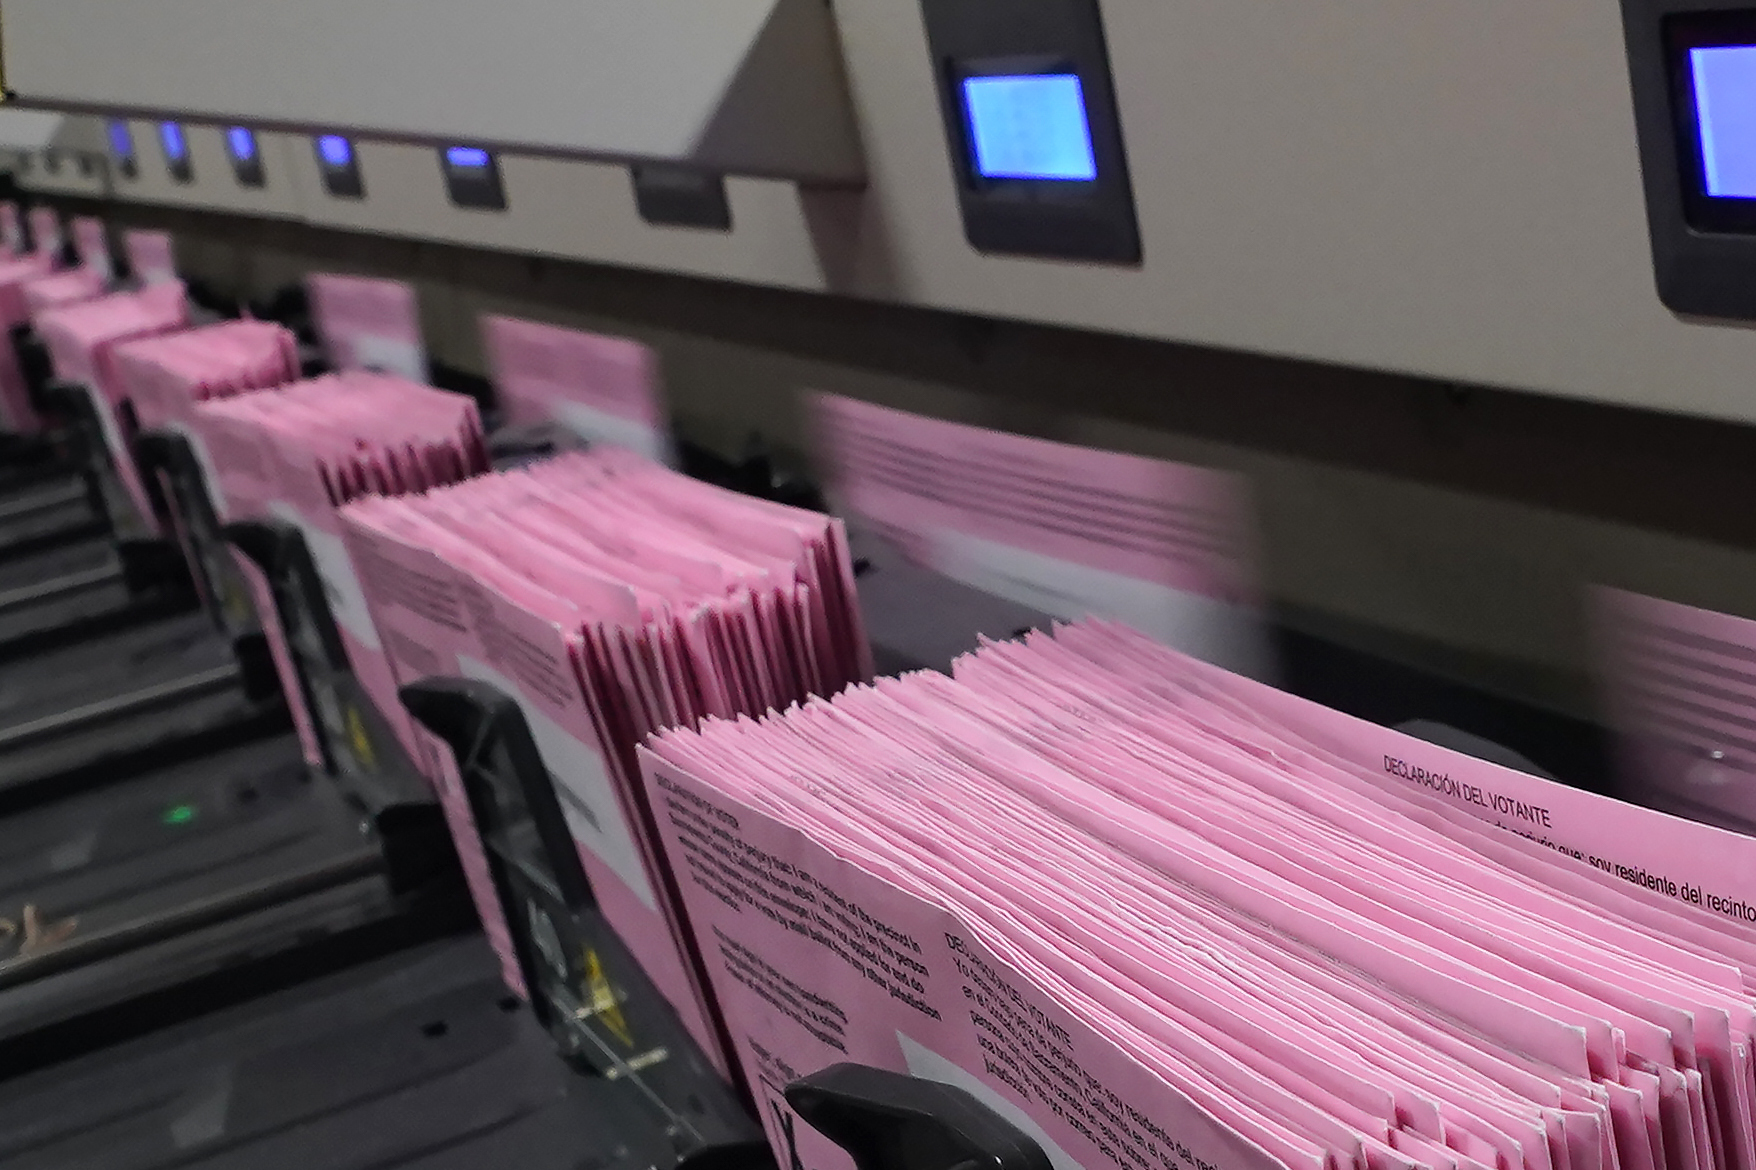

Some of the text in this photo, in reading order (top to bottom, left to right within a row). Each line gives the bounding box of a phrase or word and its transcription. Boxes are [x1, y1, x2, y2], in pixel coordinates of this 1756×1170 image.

[1383, 755, 1553, 829] DECLARACIÓN DEL VOTANTE
[1615, 863, 1677, 897] residente
[1680, 882, 1703, 906] del
[1706, 892, 1756, 923] recinto
